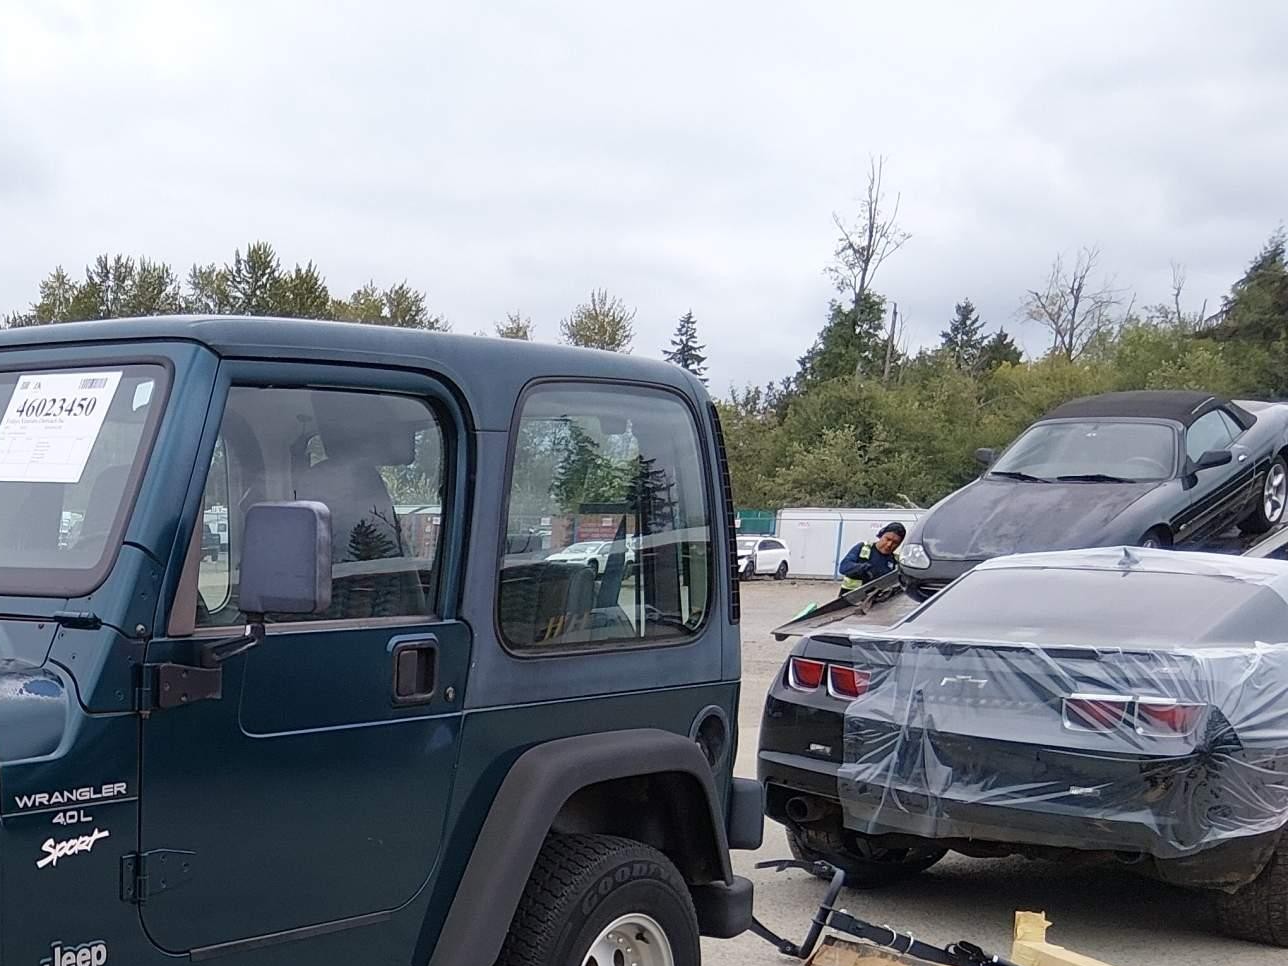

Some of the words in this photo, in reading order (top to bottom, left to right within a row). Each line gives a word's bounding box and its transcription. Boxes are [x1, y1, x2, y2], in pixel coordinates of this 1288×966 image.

[16, 396, 98, 418] 46023450
[14, 782, 127, 809] WRANGLER
[35, 828, 110, 869] Sport
